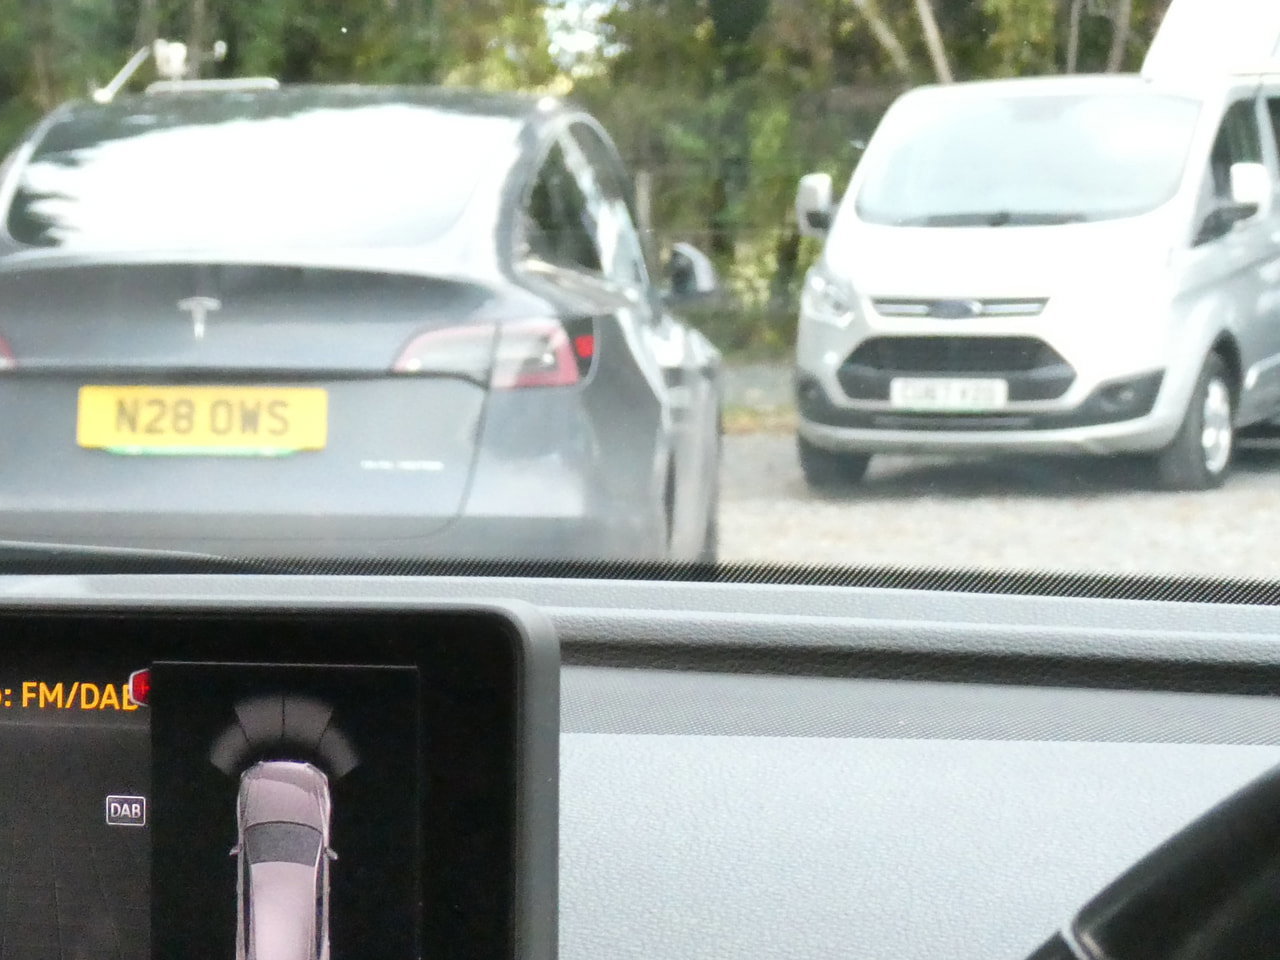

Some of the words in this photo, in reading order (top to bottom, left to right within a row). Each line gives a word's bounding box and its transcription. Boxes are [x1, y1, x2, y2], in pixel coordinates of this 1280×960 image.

[115, 398, 195, 435] N28
[209, 398, 289, 435] OWS
[110, 803, 141, 818] DAB
